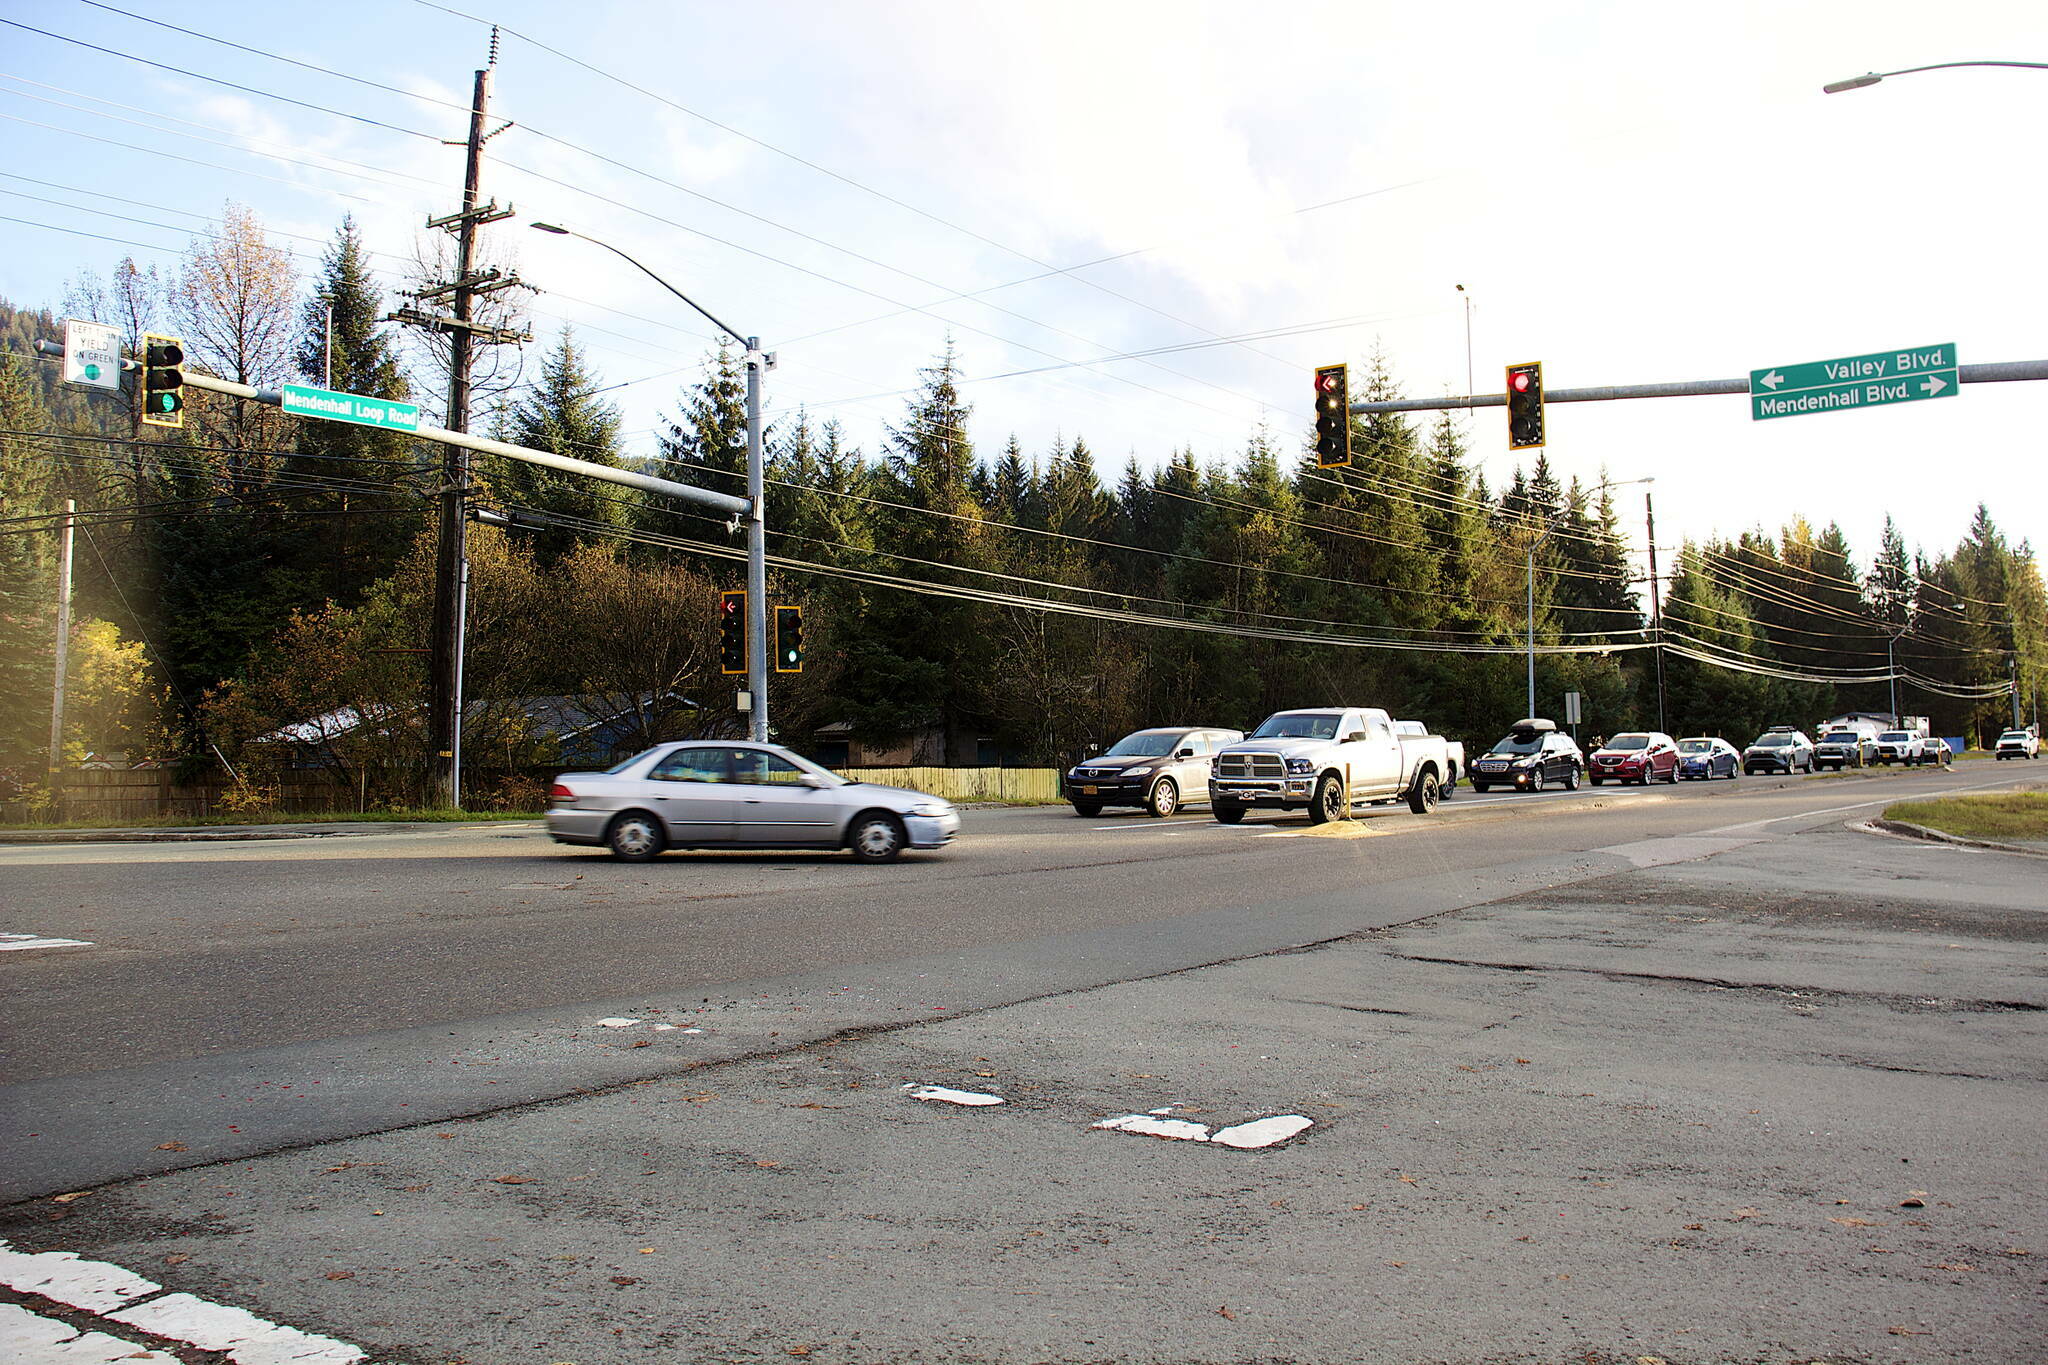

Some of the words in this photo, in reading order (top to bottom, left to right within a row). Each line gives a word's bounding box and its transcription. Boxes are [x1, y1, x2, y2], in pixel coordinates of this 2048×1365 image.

[73, 325, 92, 335] LEFT
[80, 337, 109, 351] YIELD
[73, 349, 85, 360] ON
[88, 352, 114, 364] GREEN
[1824, 360, 1887, 380] Valley
[1896, 349, 1947, 371] Blvd.
[284, 390, 353, 416] Mendenhall
[356, 402, 385, 424] Loop
[388, 407, 417, 426] Road
[1760, 388, 1860, 416] Mendenhall
[1866, 382, 1911, 402] Blvd.
